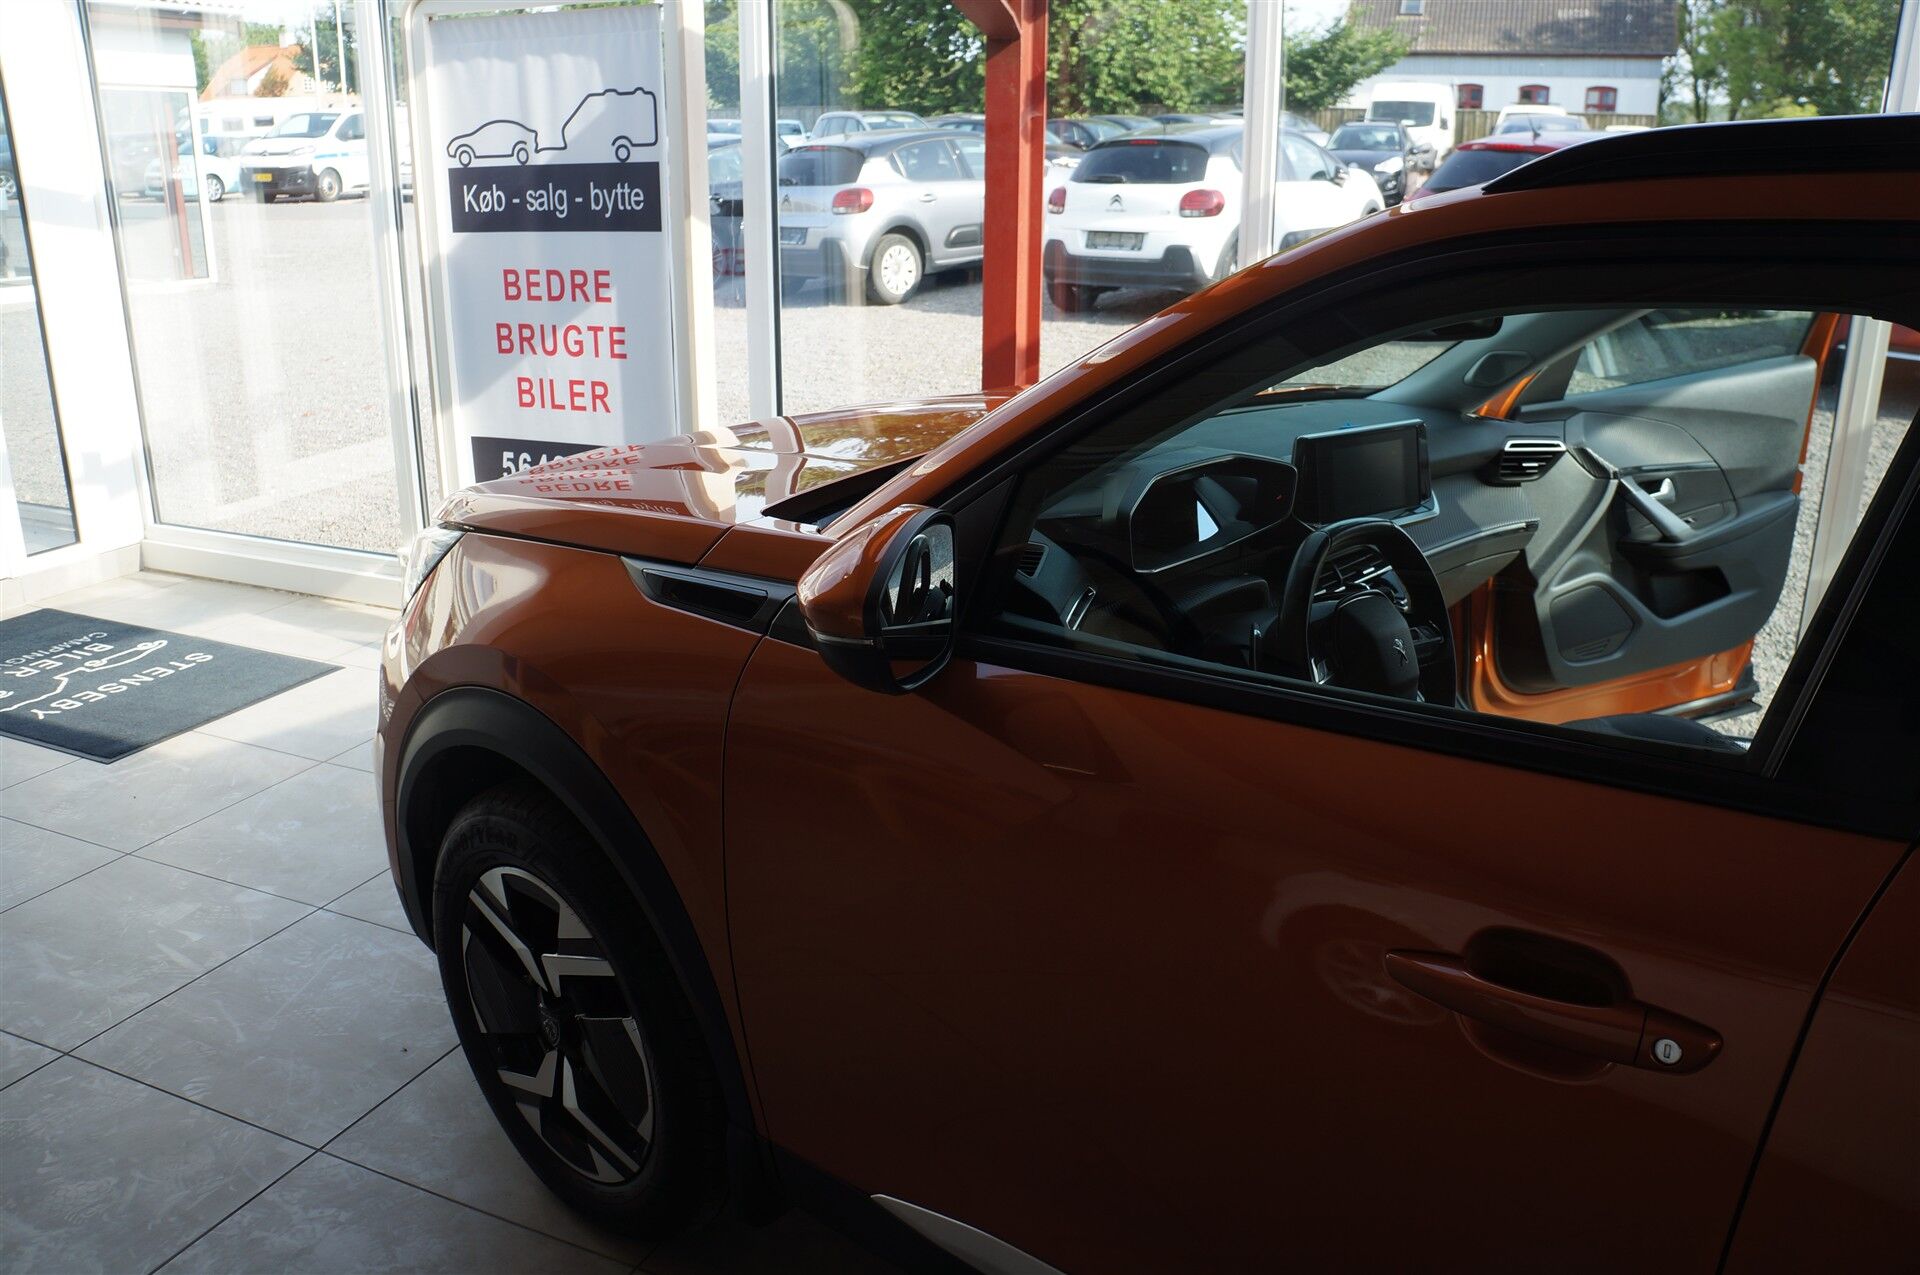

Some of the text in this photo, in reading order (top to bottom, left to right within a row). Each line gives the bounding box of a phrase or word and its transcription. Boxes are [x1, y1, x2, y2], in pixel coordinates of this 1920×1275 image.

[463, 184, 506, 213] Køb
[526, 182, 569, 218] salg
[590, 181, 645, 219] bytte
[502, 268, 613, 304] BEDRE
[495, 322, 629, 360] BRUGTE
[516, 376, 612, 414] BILER
[502, 451, 564, 478] 56
[4, 642, 115, 677] BILER
[30, 652, 214, 720] STENSEBY
